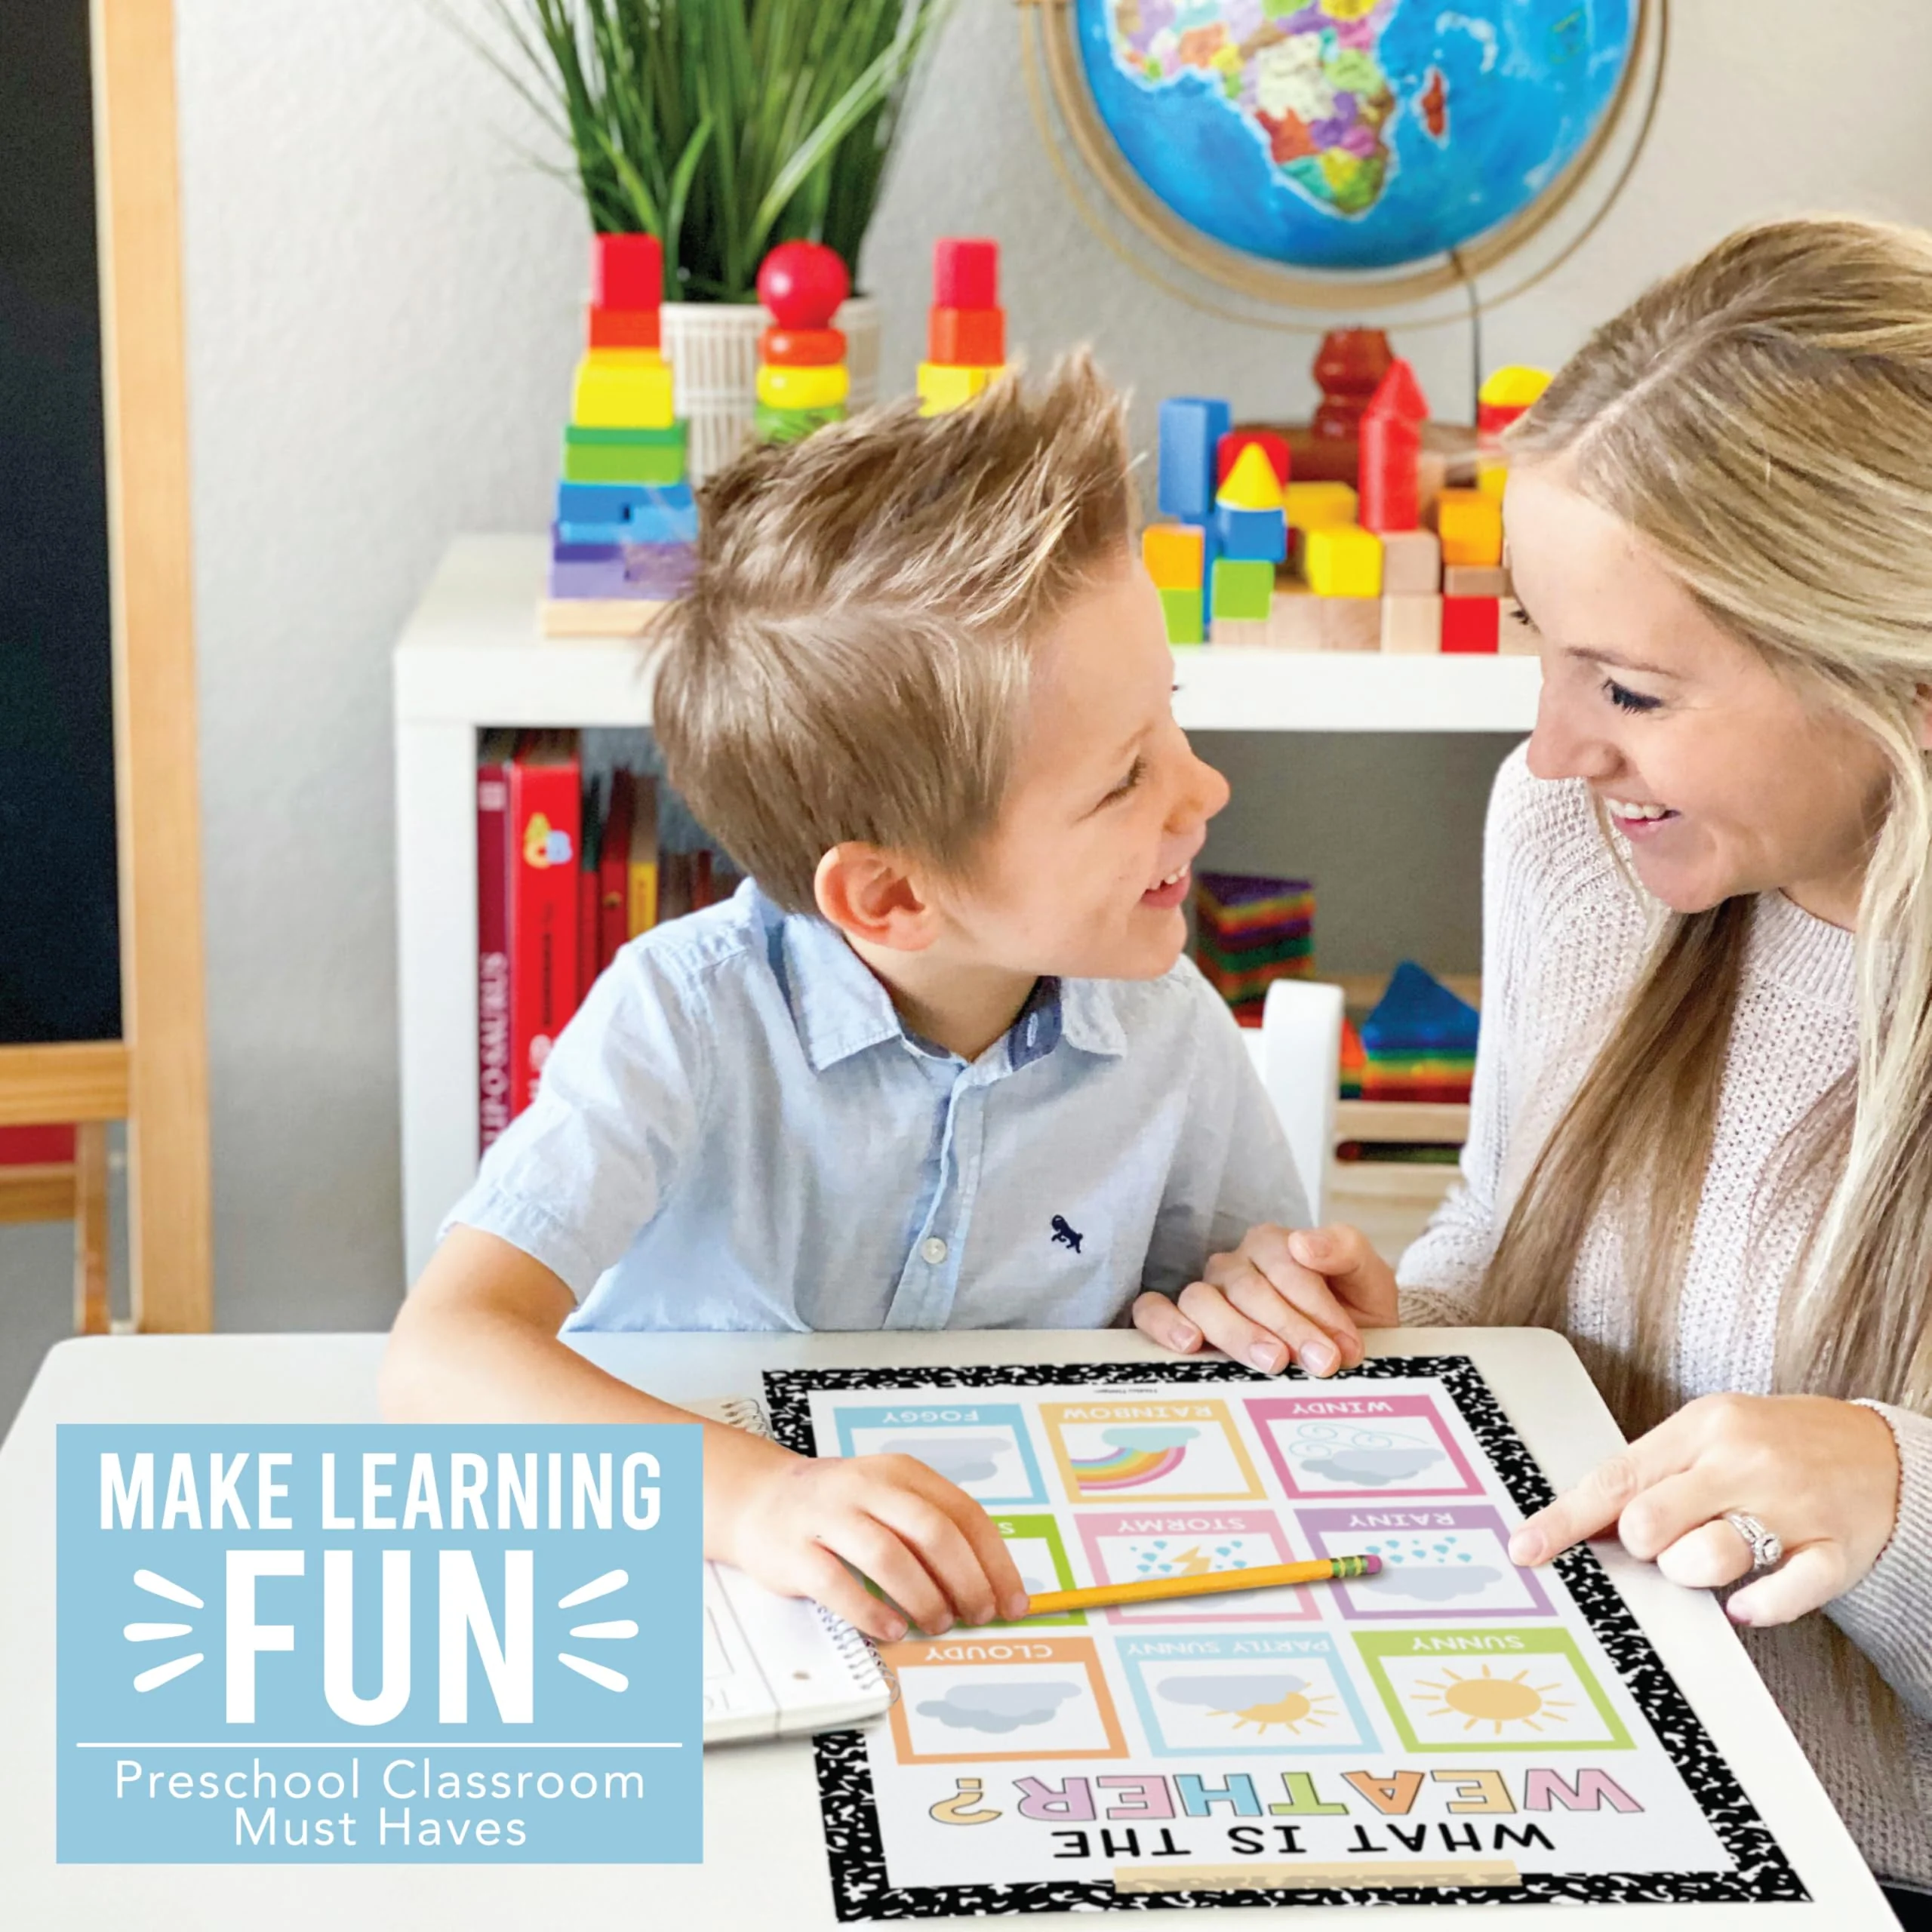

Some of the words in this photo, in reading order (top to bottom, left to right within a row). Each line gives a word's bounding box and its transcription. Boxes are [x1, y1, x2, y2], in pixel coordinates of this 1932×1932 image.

[881, 1407, 979, 1423] FOGGY
[1063, 1406, 1212, 1420] RAINBOW
[1294, 1402, 1392, 1414] WINDY
[1119, 1518, 1245, 1531] STORMY
[1350, 1513, 1454, 1526] RAINY
[1128, 1641, 1220, 1657] SUNNY
[1233, 1639, 1330, 1654] PARTLY
[1414, 1636, 1524, 1650] SUNNY
[926, 1645, 1052, 1660] CLOUDY
[929, 1767, 1645, 1825] WEATHER?
[1052, 1829, 1190, 1857] THE
[1229, 1826, 1306, 1854] IS
[1349, 1823, 1554, 1852] WHAT
